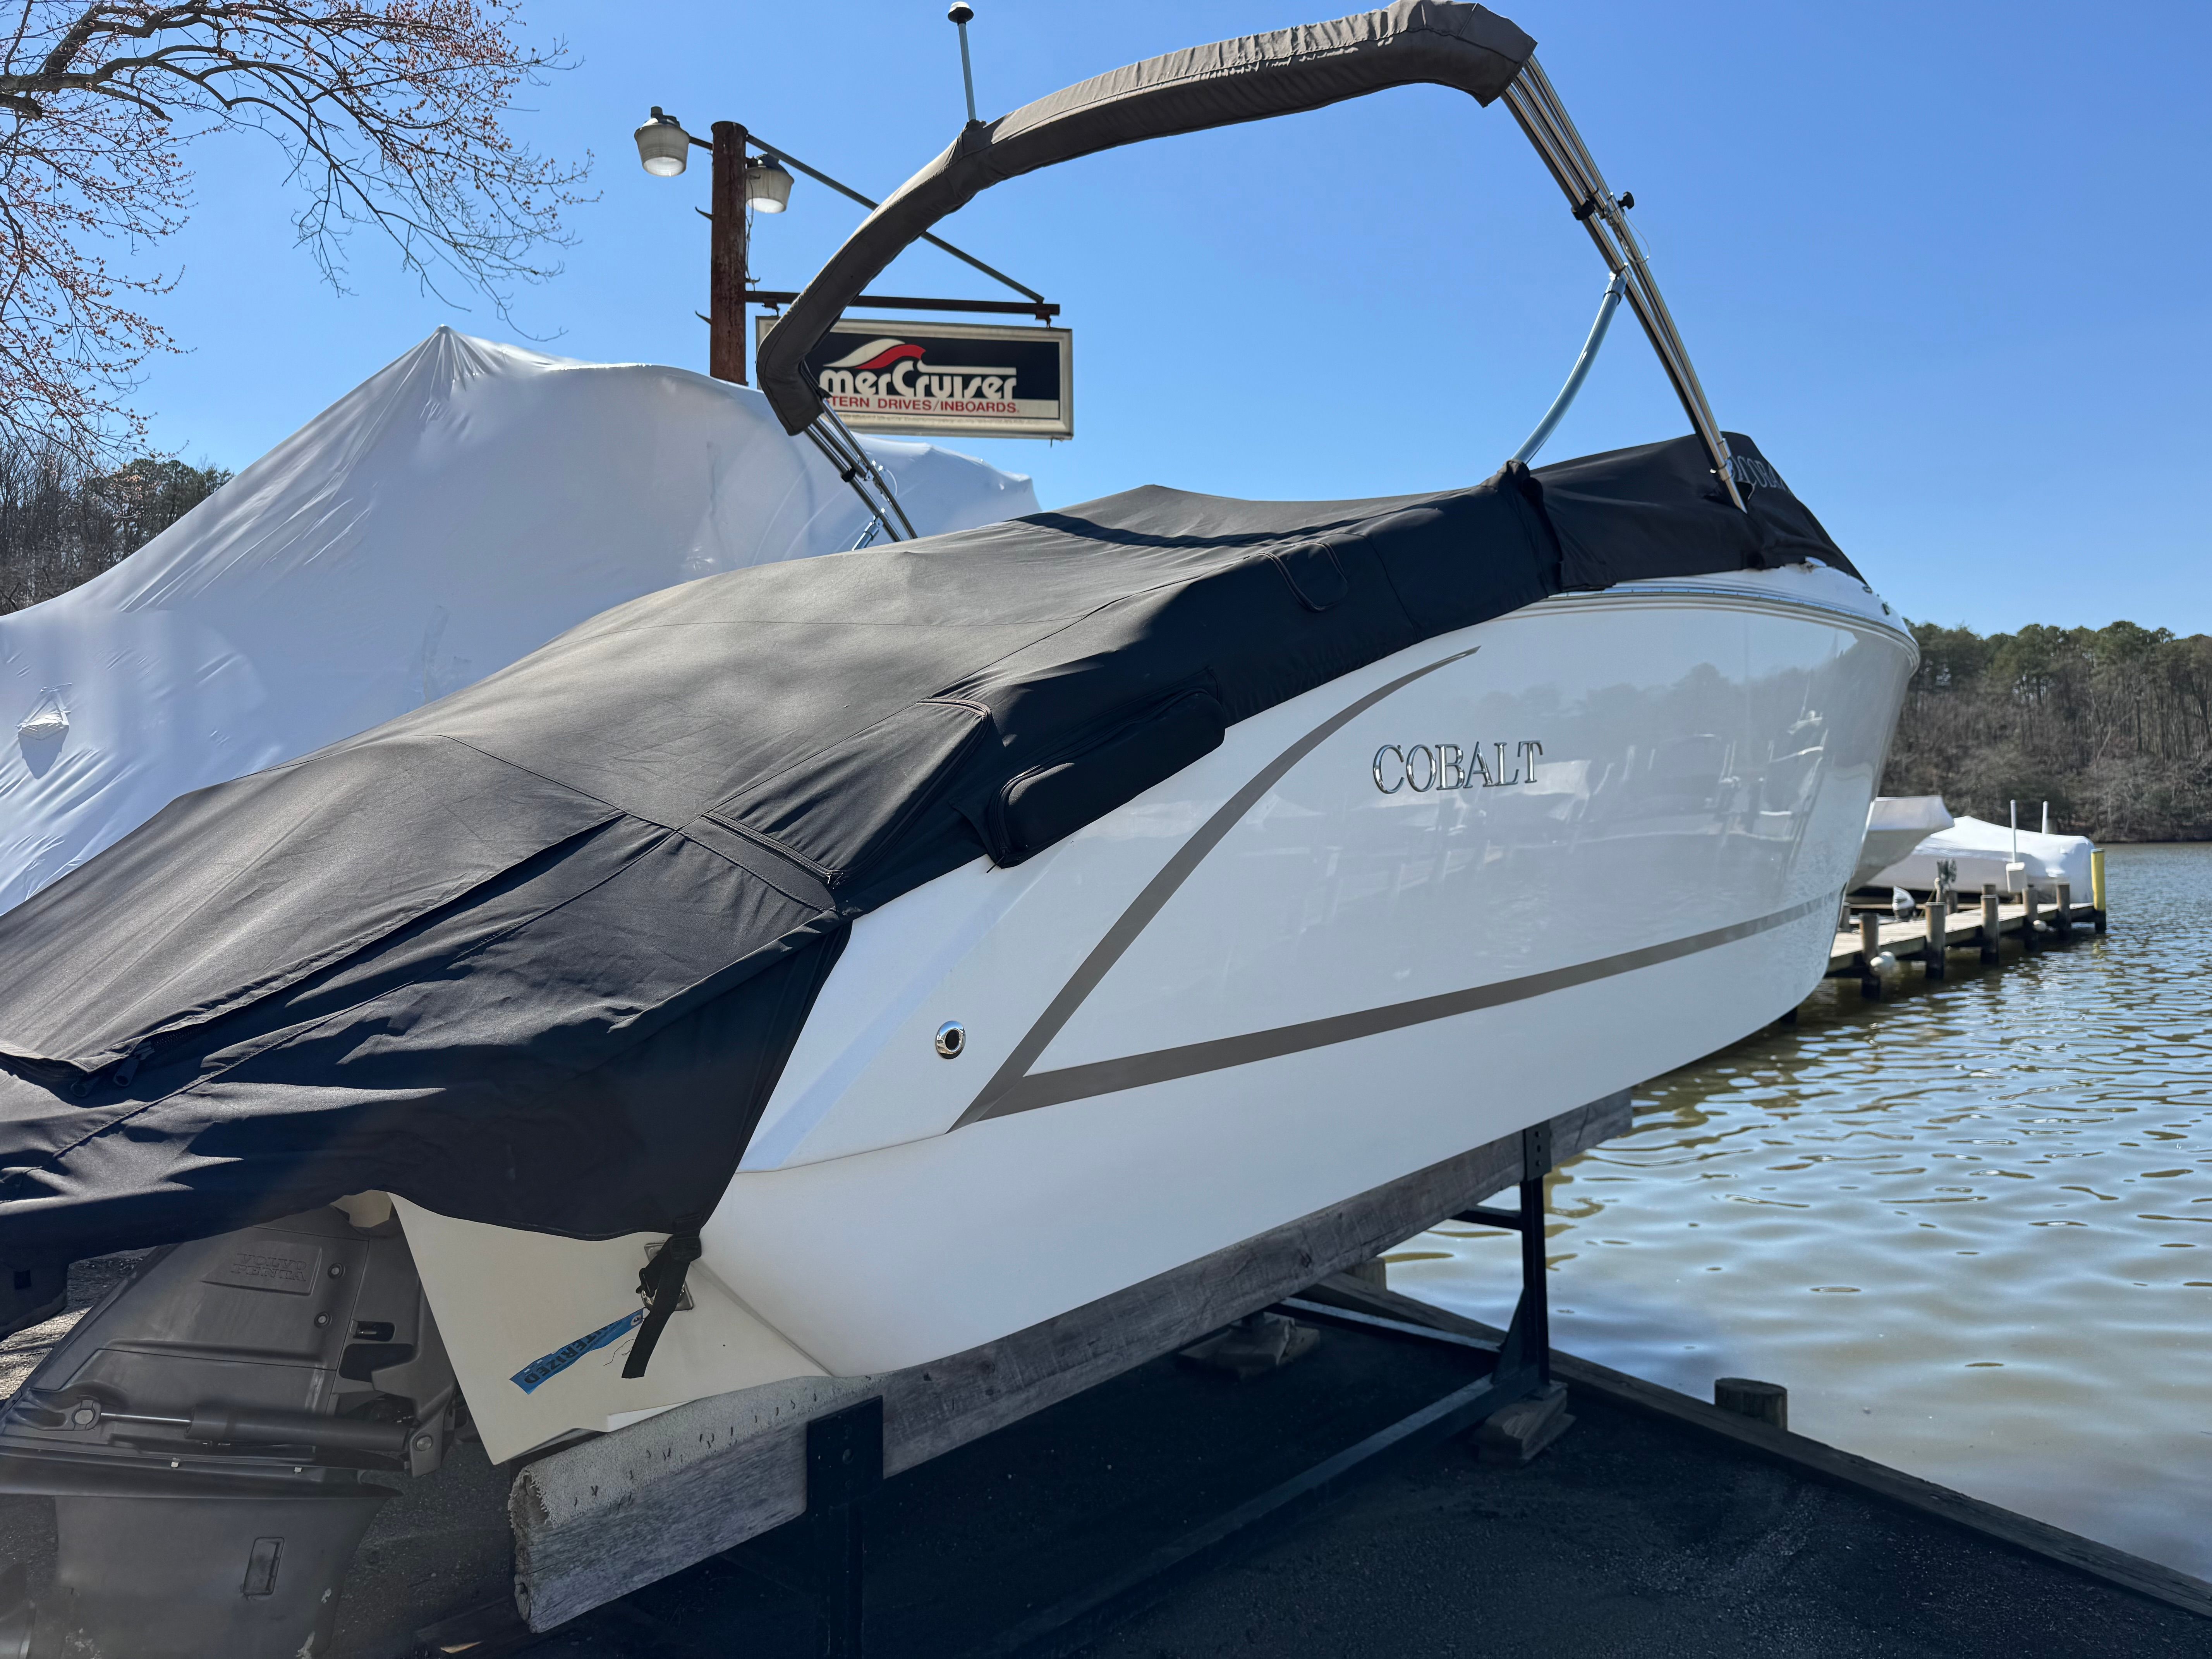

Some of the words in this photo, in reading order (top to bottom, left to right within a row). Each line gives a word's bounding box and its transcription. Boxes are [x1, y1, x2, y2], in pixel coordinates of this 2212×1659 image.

[826, 396, 870, 407] TERN
[1737, 455, 1792, 495] COBA
[1373, 740, 1543, 794] COBALT
[230, 1263, 306, 1281] PENTA
[237, 1253, 307, 1271] VOLVO
[524, 1326, 609, 1384] TERIZED
